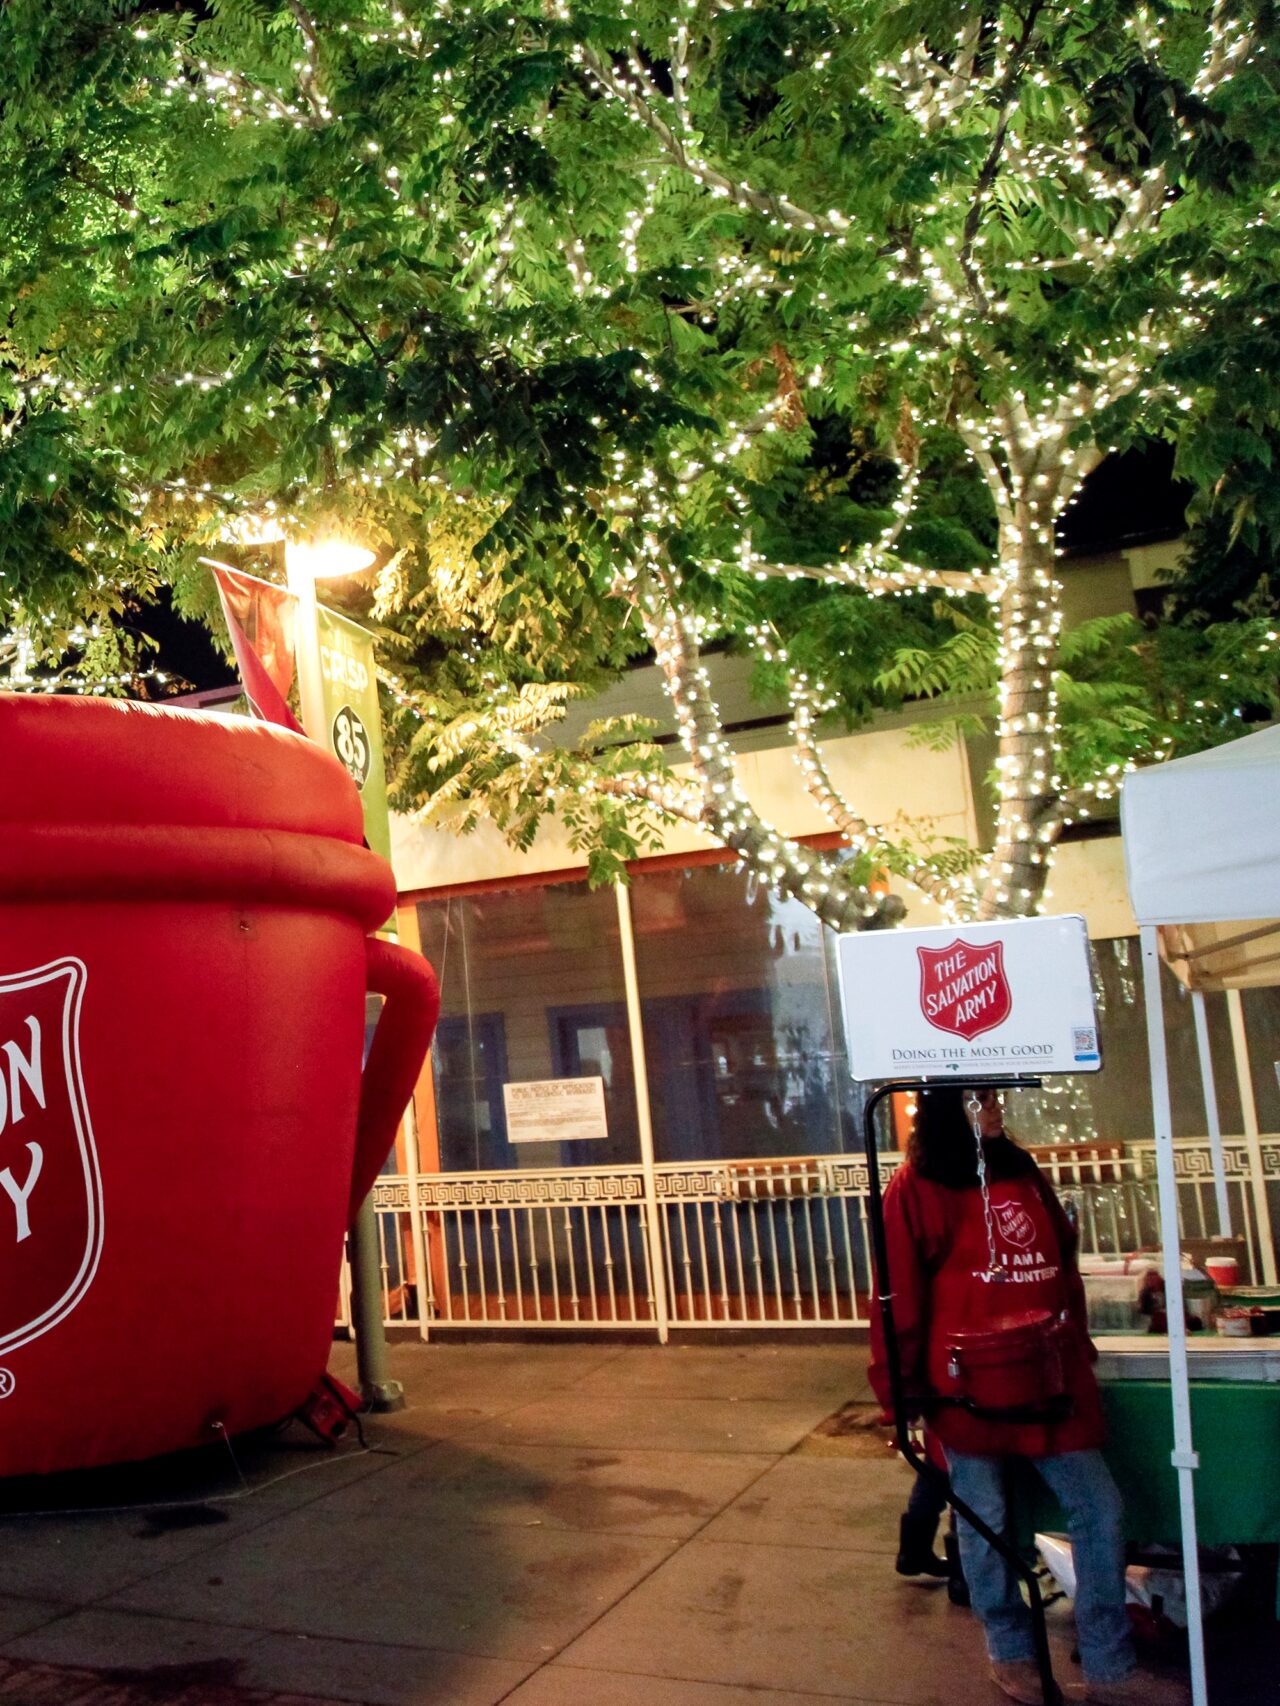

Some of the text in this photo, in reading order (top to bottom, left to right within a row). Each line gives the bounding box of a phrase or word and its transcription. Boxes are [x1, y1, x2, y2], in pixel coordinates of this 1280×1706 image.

[336, 714, 366, 769] 85
[926, 952, 997, 1016] SALVATION
[934, 950, 967, 982] THE
[955, 980, 997, 1028] ARMY
[1011, 1044, 1053, 1055] GOOD
[1001, 1252, 1046, 1266] I AM A
